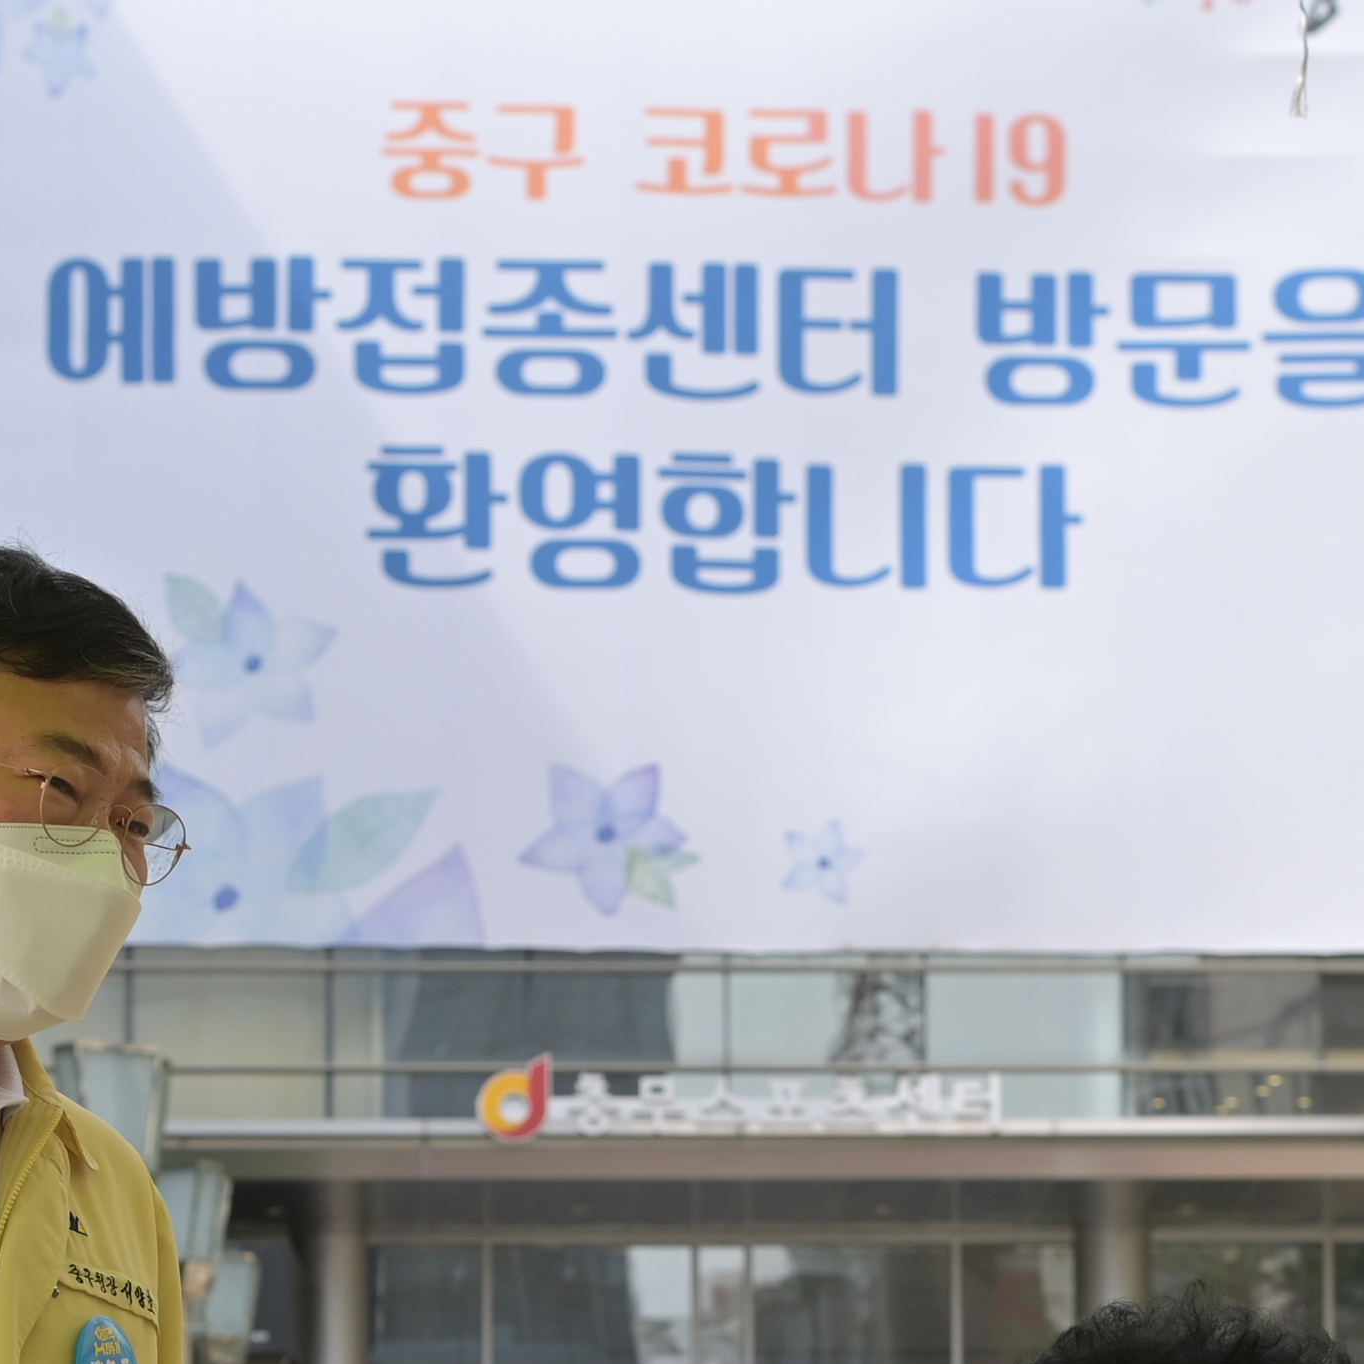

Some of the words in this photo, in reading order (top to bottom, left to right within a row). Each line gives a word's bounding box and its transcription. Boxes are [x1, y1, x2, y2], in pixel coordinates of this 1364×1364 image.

[382, 100, 585, 201] 중구
[637, 107, 1069, 207] 코로나19
[46, 254, 900, 400] 예방접종센터
[368, 445, 1083, 594] 환영합니다
[68, 1264, 118, 1297] 중구청장
[120, 1280, 156, 1316] 서양호
